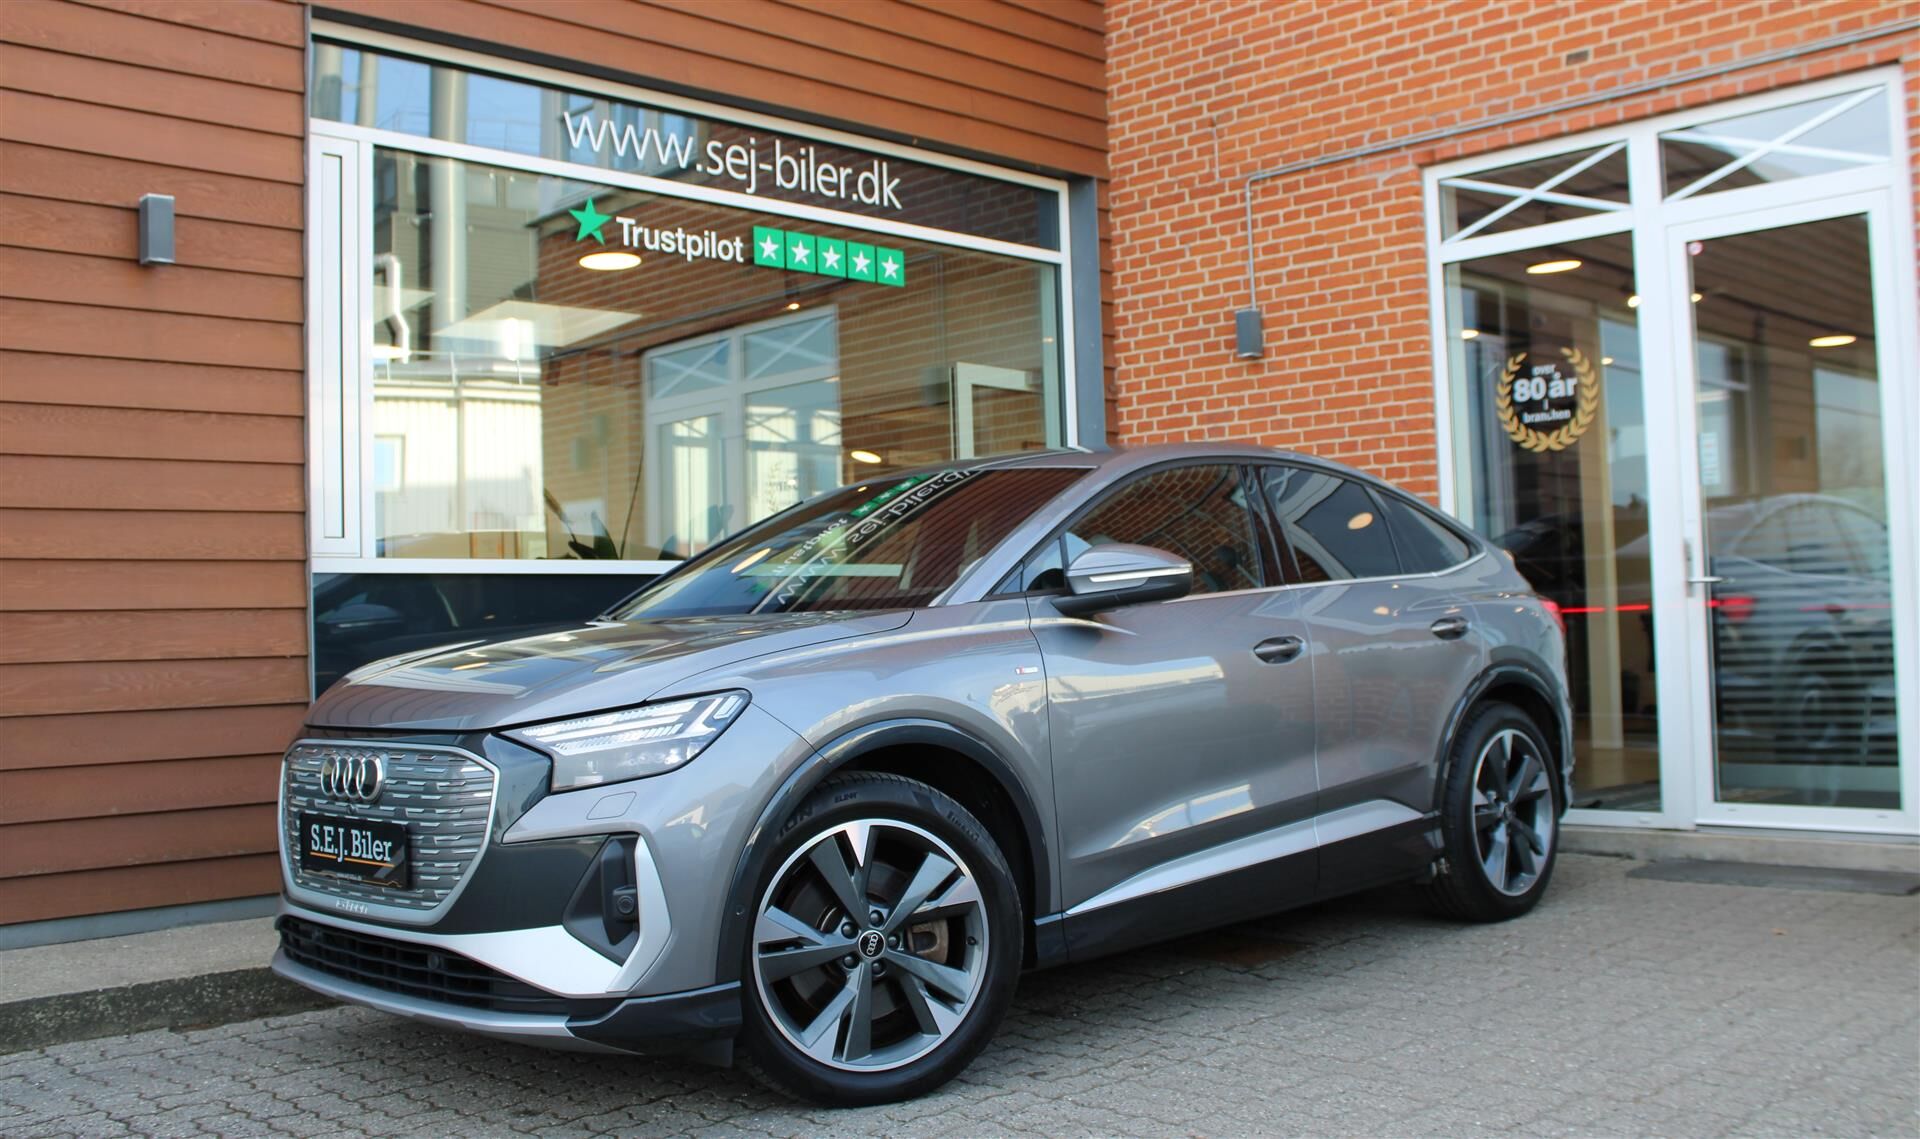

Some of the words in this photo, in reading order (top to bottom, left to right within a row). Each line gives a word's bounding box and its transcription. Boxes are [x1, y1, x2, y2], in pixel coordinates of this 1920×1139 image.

[564, 111, 903, 210] www.sej-biler.dk
[616, 216, 745, 263] Trustpilot
[1513, 377, 1547, 402] 80
[1548, 371, 1578, 399] år
[1532, 364, 1556, 376] over
[1523, 409, 1571, 424] branchen
[310, 823, 348, 862] S.E.J.
[351, 829, 393, 862] Biler
